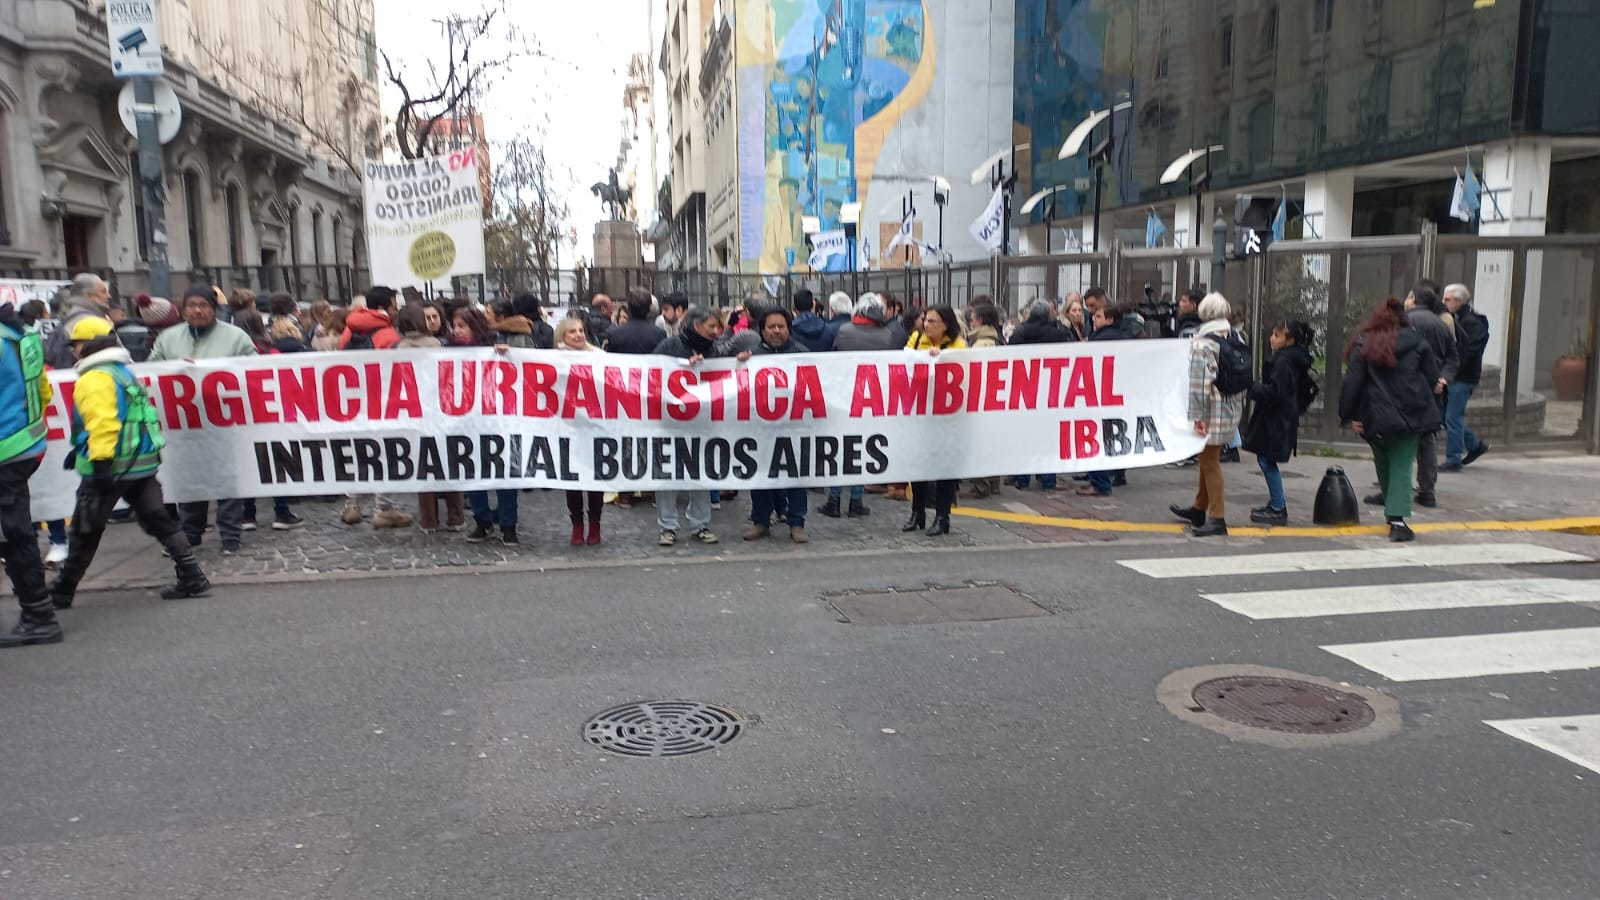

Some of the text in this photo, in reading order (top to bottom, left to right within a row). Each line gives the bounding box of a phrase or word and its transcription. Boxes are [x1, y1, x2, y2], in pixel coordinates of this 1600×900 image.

[45, 355, 1123, 441] ERGENCIA URBANISTICA AMBIENTAL
[254, 434, 888, 484] INTERBARRIAL BUENOS AIRES
[1059, 416, 1165, 459] IBBA
